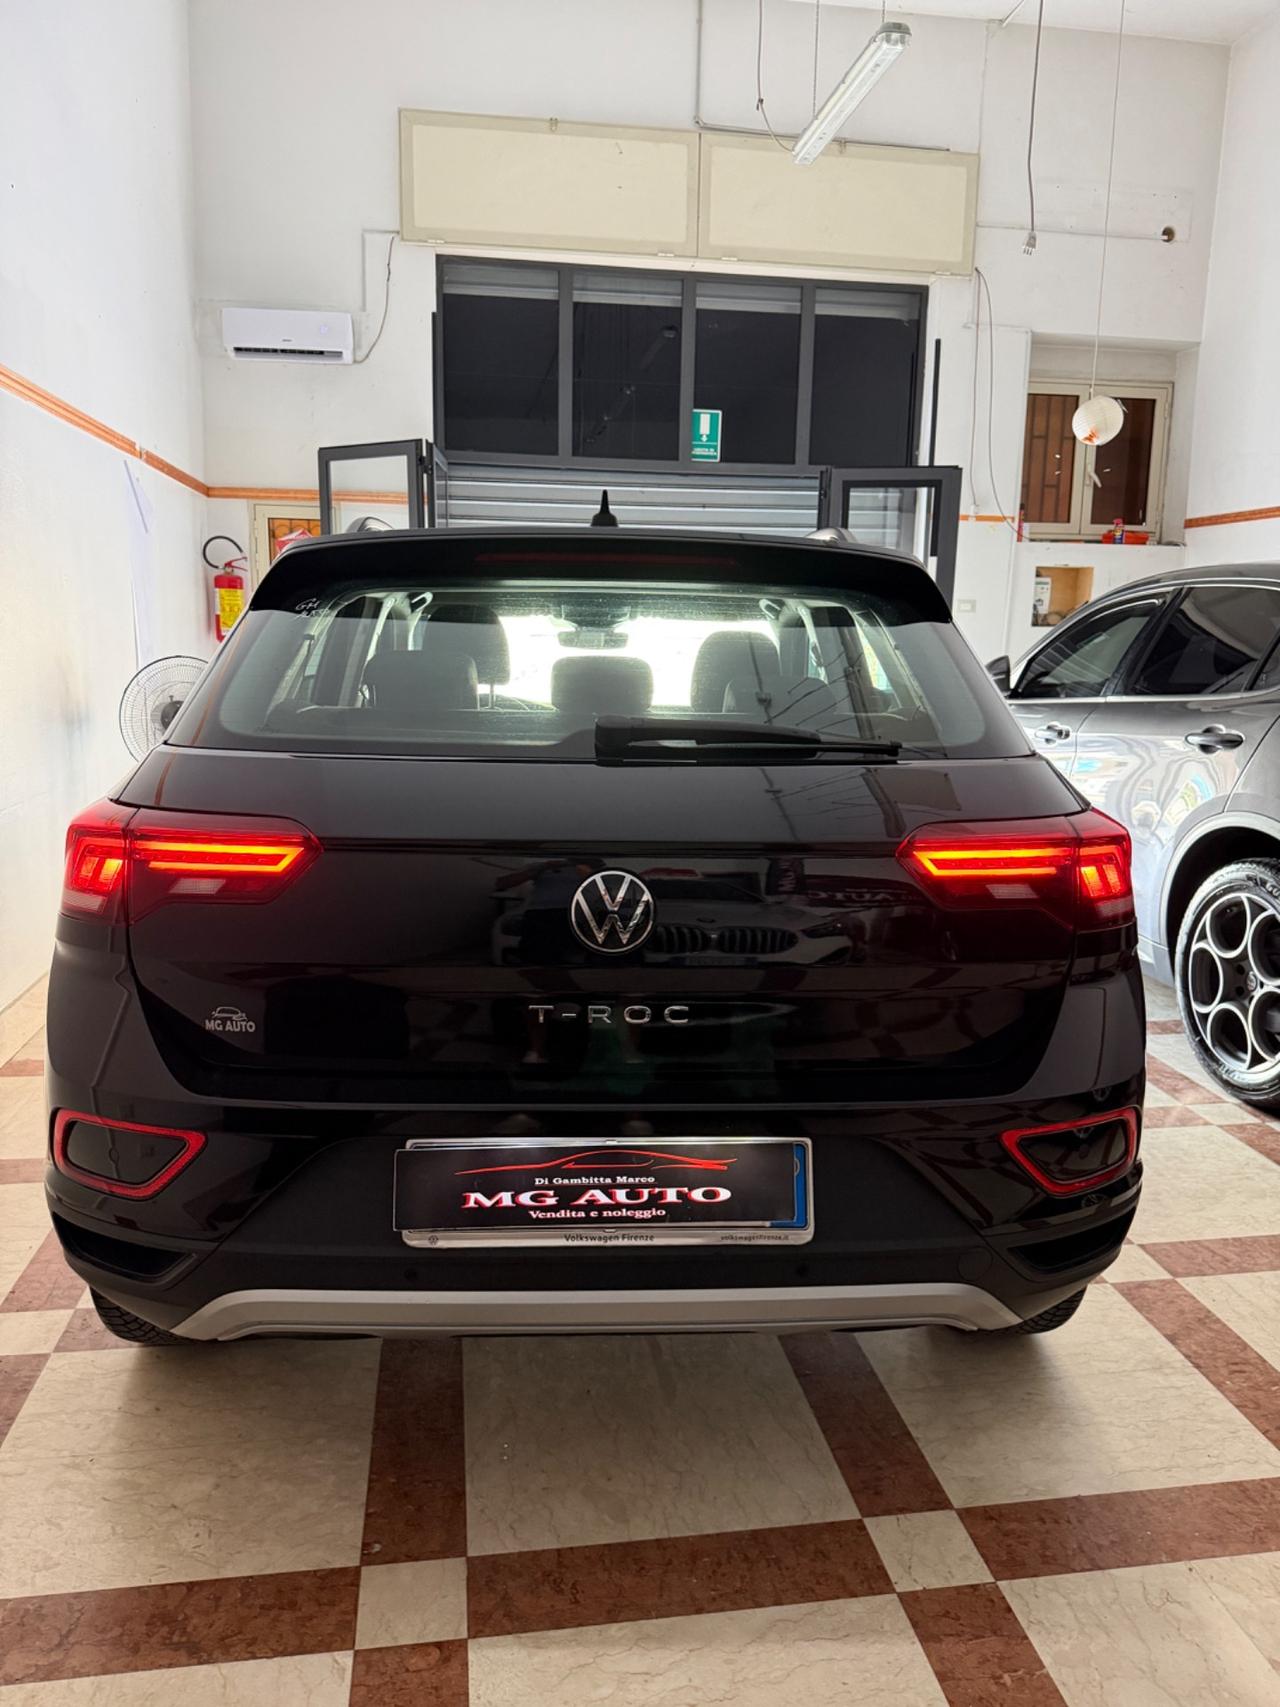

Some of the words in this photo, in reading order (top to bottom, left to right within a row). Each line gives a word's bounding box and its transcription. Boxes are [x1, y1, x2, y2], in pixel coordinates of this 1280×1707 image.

[528, 1005, 689, 1023] T-ROC
[205, 1019, 223, 1031] MG
[225, 1020, 256, 1032] AUTO
[534, 1177, 549, 1185] Di
[553, 1176, 612, 1185] Gambitta
[461, 1190, 559, 1208] MG
[569, 1187, 732, 1206] AUTO
[528, 1209, 586, 1218] Vendita
[602, 1208, 666, 1219] noleggio
[564, 1233, 619, 1243] Volkswagen
[621, 1233, 655, 1241] Firenze
